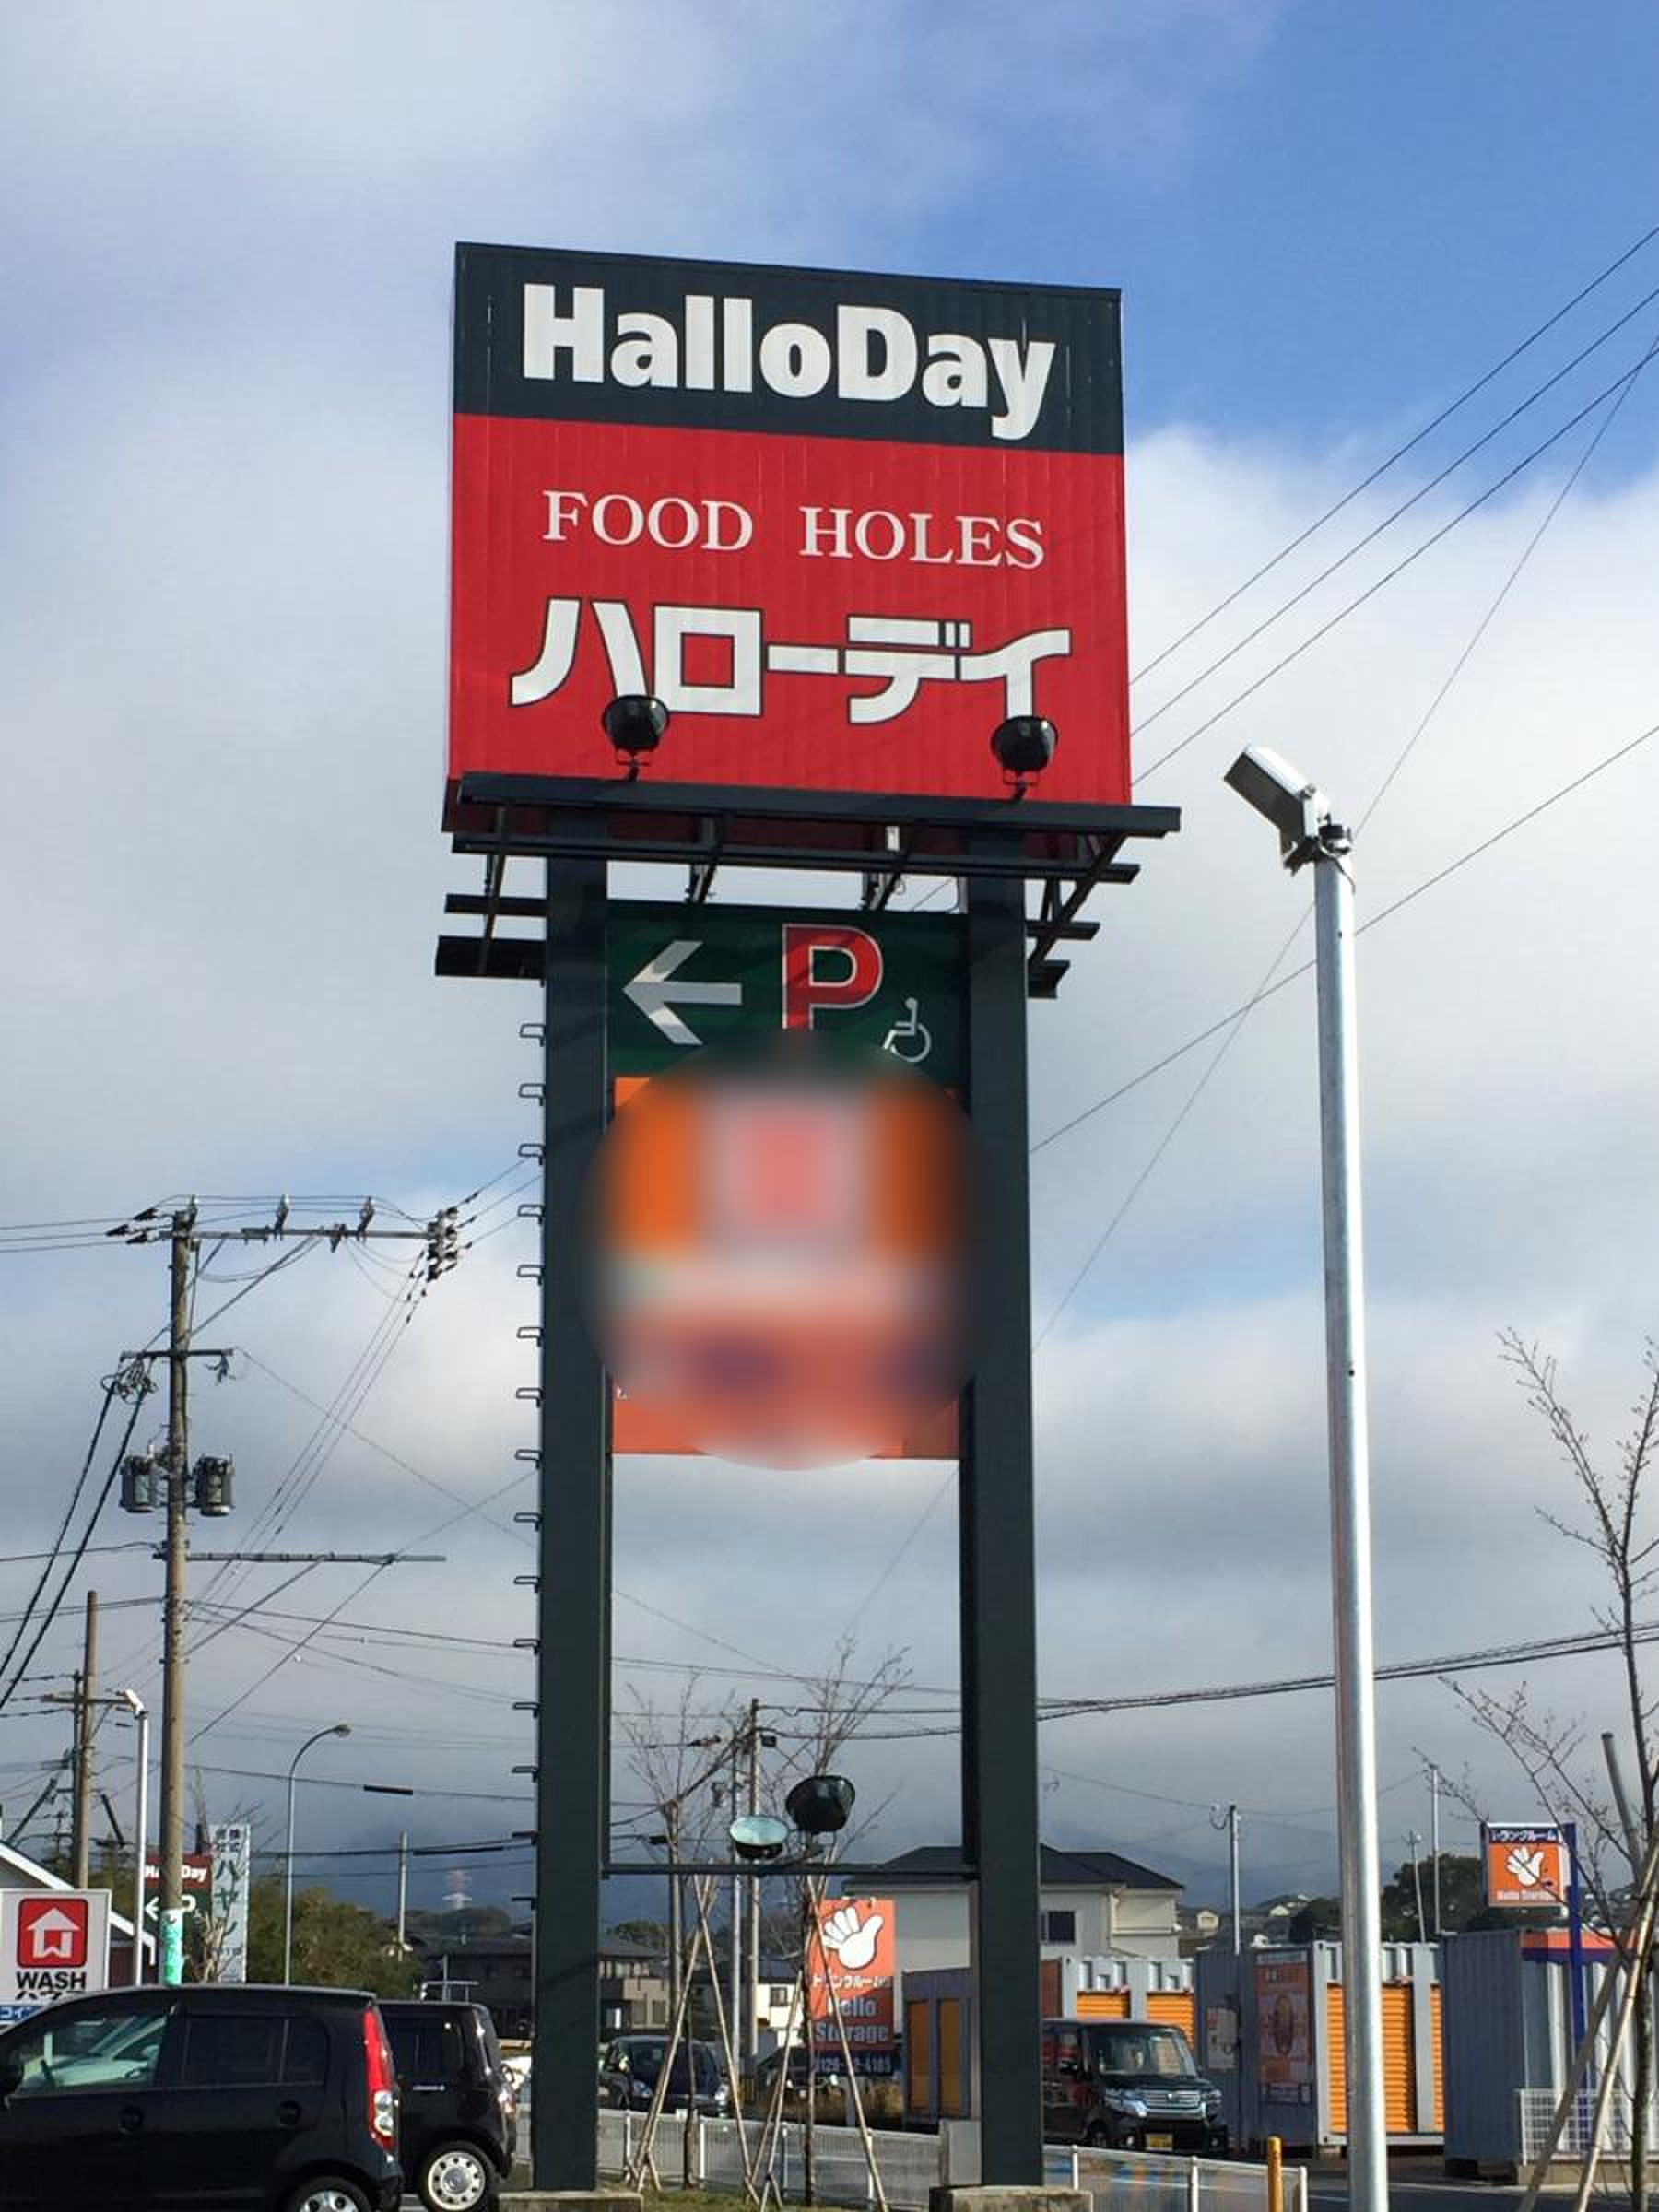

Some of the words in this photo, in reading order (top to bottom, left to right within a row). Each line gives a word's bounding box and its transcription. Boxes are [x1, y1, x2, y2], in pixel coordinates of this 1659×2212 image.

[522, 282, 1056, 441] HalloDay
[542, 489, 754, 553] FOOD
[799, 505, 1045, 570] HOLES
[781, 923, 885, 1032] P
[16, 1971, 87, 1990] WASH
